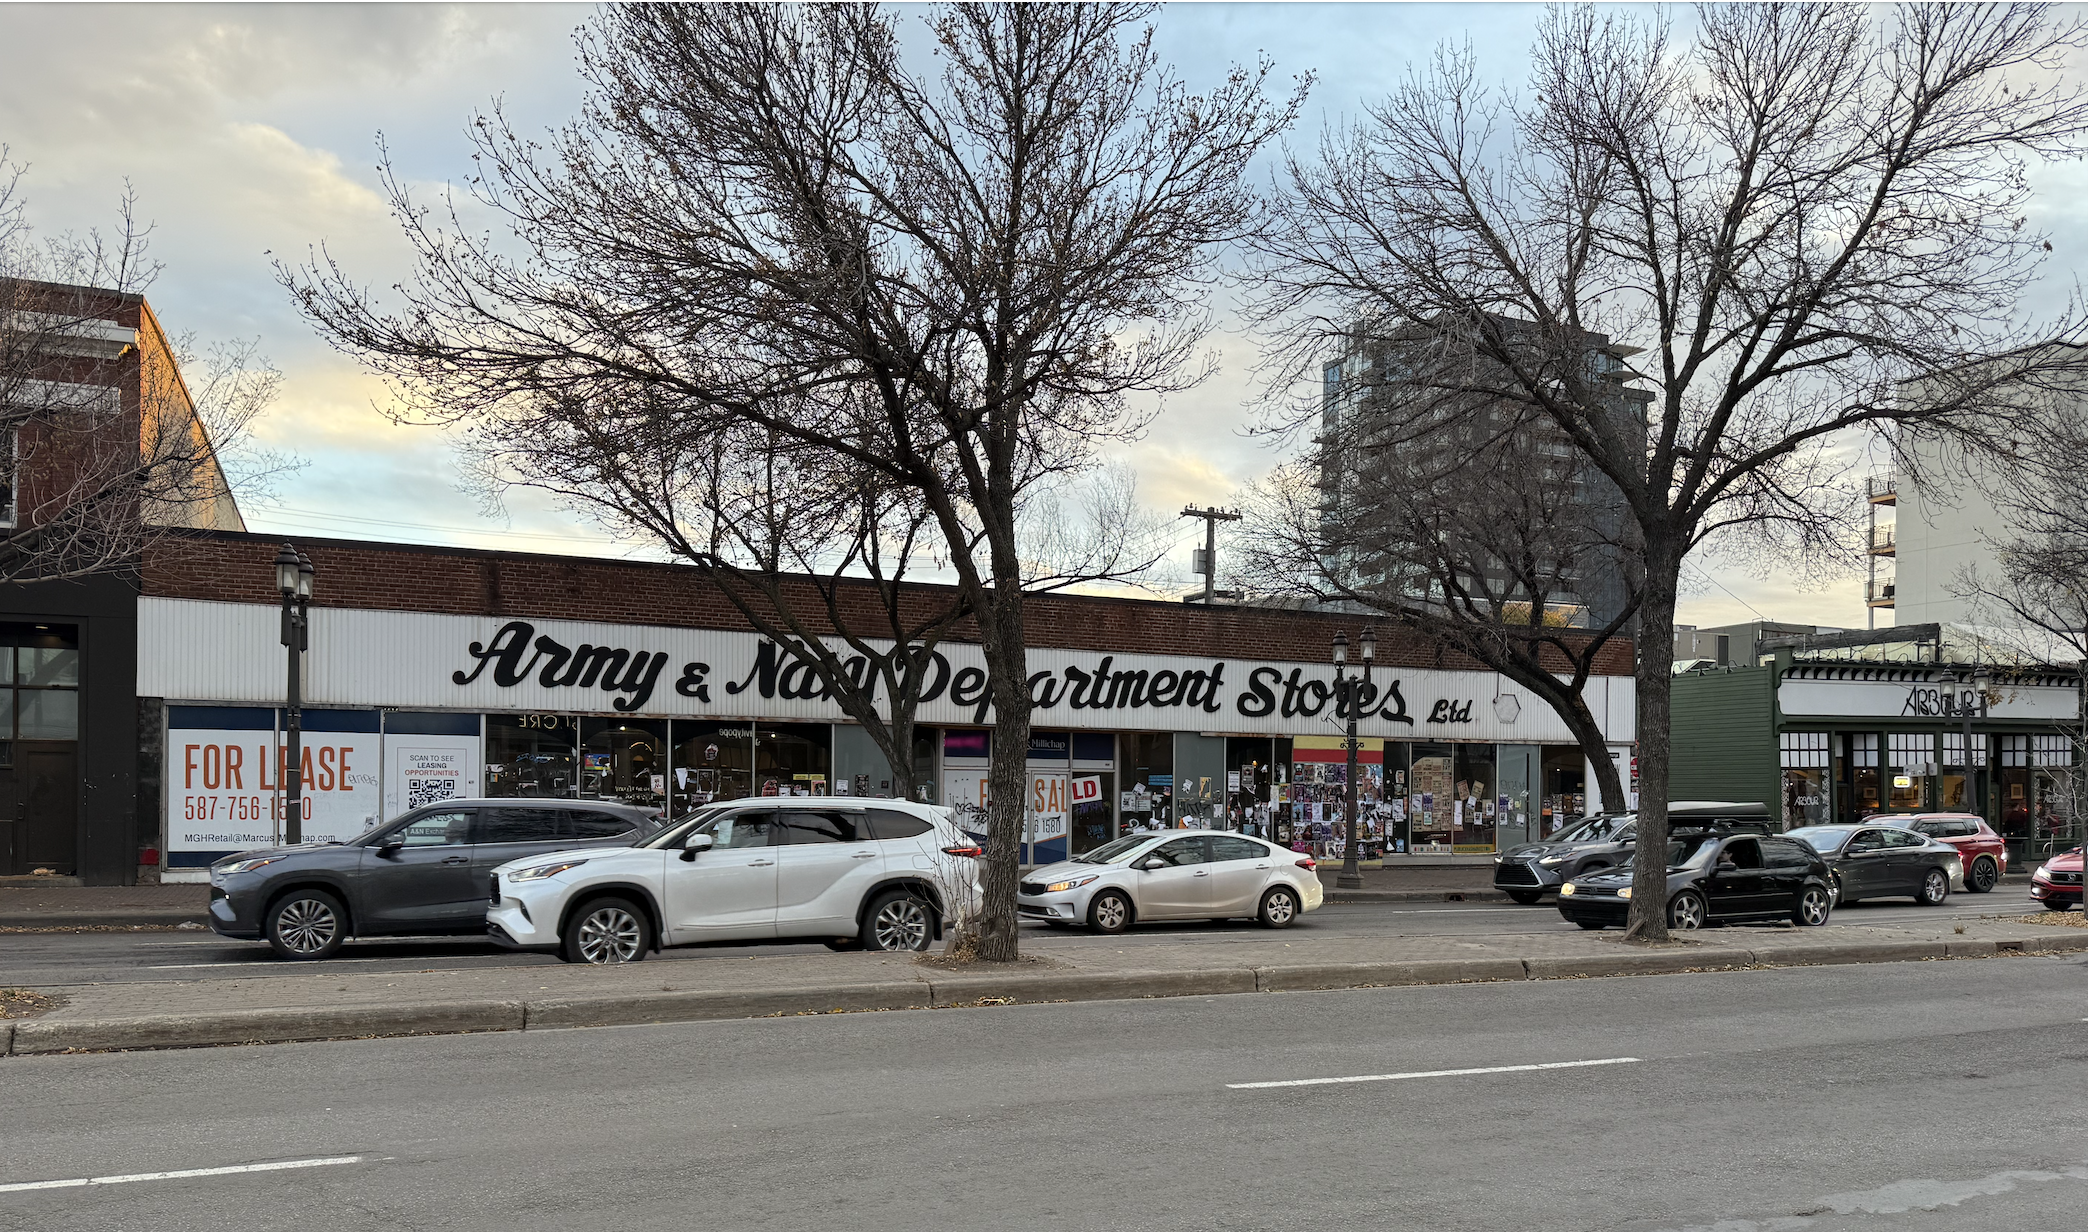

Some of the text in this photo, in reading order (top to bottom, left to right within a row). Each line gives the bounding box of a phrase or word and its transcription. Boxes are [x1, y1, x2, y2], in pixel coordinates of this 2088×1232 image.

[452, 621, 669, 711] Army
[675, 662, 711, 703] &
[725, 638, 883, 706] Nay
[1237, 666, 1414, 726] Stores
[1426, 698, 1473, 723] Ltd
[1031, 738, 1066, 750] Millichap
[409, 754, 429, 762] SCAN
[430, 754, 440, 762] TO
[185, 744, 354, 791] FOR LEASE
[404, 769, 459, 777] OPPORTUNITIES
[1034, 778, 1067, 813] SAL
[1072, 780, 1097, 800] LD
[185, 795, 312, 821] 587-756-150
[1794, 795, 1819, 806] ARBOUR
[1042, 819, 1061, 833] 1580
